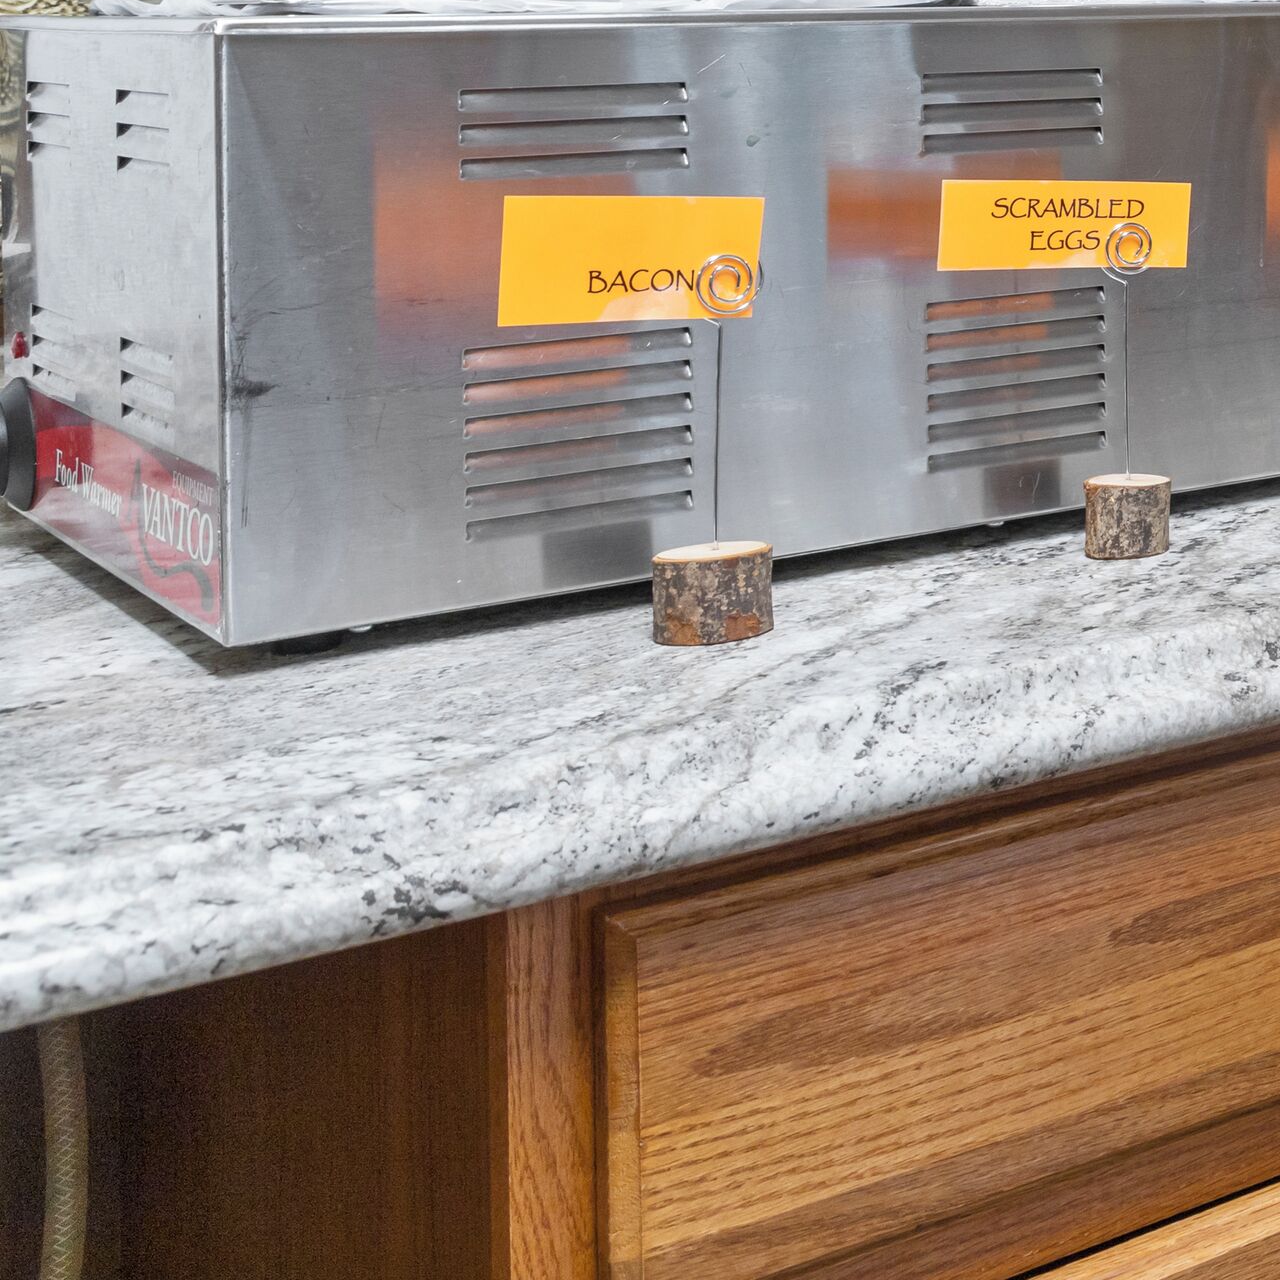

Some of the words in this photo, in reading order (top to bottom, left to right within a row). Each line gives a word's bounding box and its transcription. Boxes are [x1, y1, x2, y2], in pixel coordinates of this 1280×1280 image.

[991, 197, 1145, 219] SCRAMBLED
[1030, 230, 1101, 251] EGGS
[587, 269, 695, 294] BACON
[55, 448, 78, 493] Food
[81, 462, 123, 518] Warmer
[172, 470, 215, 507] EQUIPMENT
